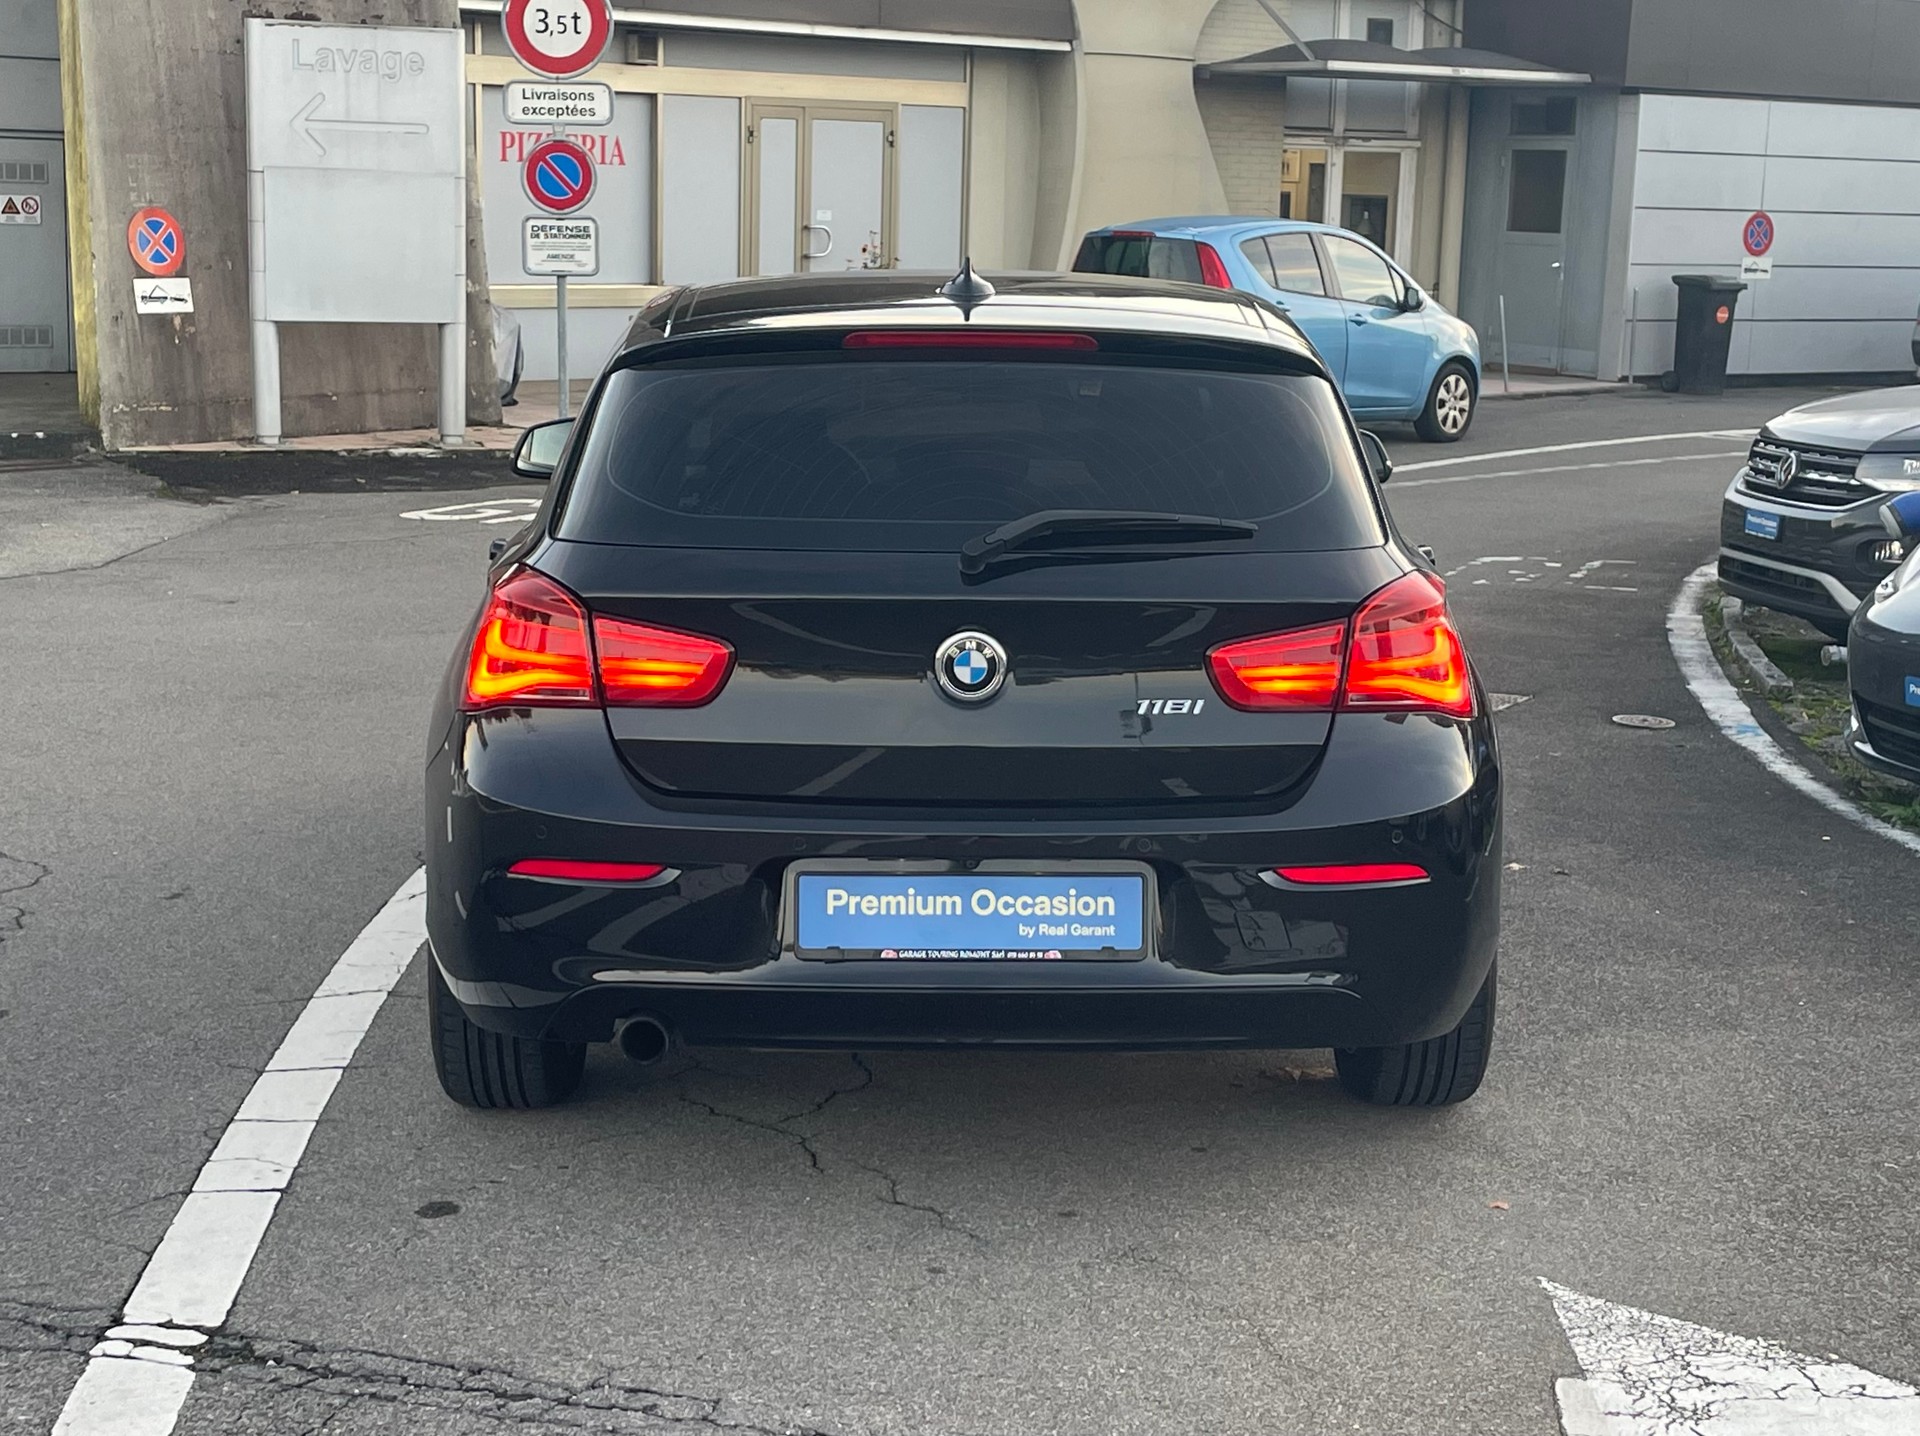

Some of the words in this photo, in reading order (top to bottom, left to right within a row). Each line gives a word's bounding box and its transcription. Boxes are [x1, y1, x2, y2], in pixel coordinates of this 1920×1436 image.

[291, 37, 425, 84] Lavage
[522, 87, 595, 102] Livraisons
[521, 104, 596, 119] exceptées
[499, 130, 627, 167] PIRIA
[531, 224, 590, 232] DEFENSE
[948, 640, 994, 659] BMW
[826, 888, 962, 917] Premium
[971, 888, 1116, 917] Occasion
[1018, 923, 1036, 938] by
[1038, 923, 1068, 936] Real
[1070, 923, 1116, 936] Garant
[898, 950, 928, 959] GARAGE
